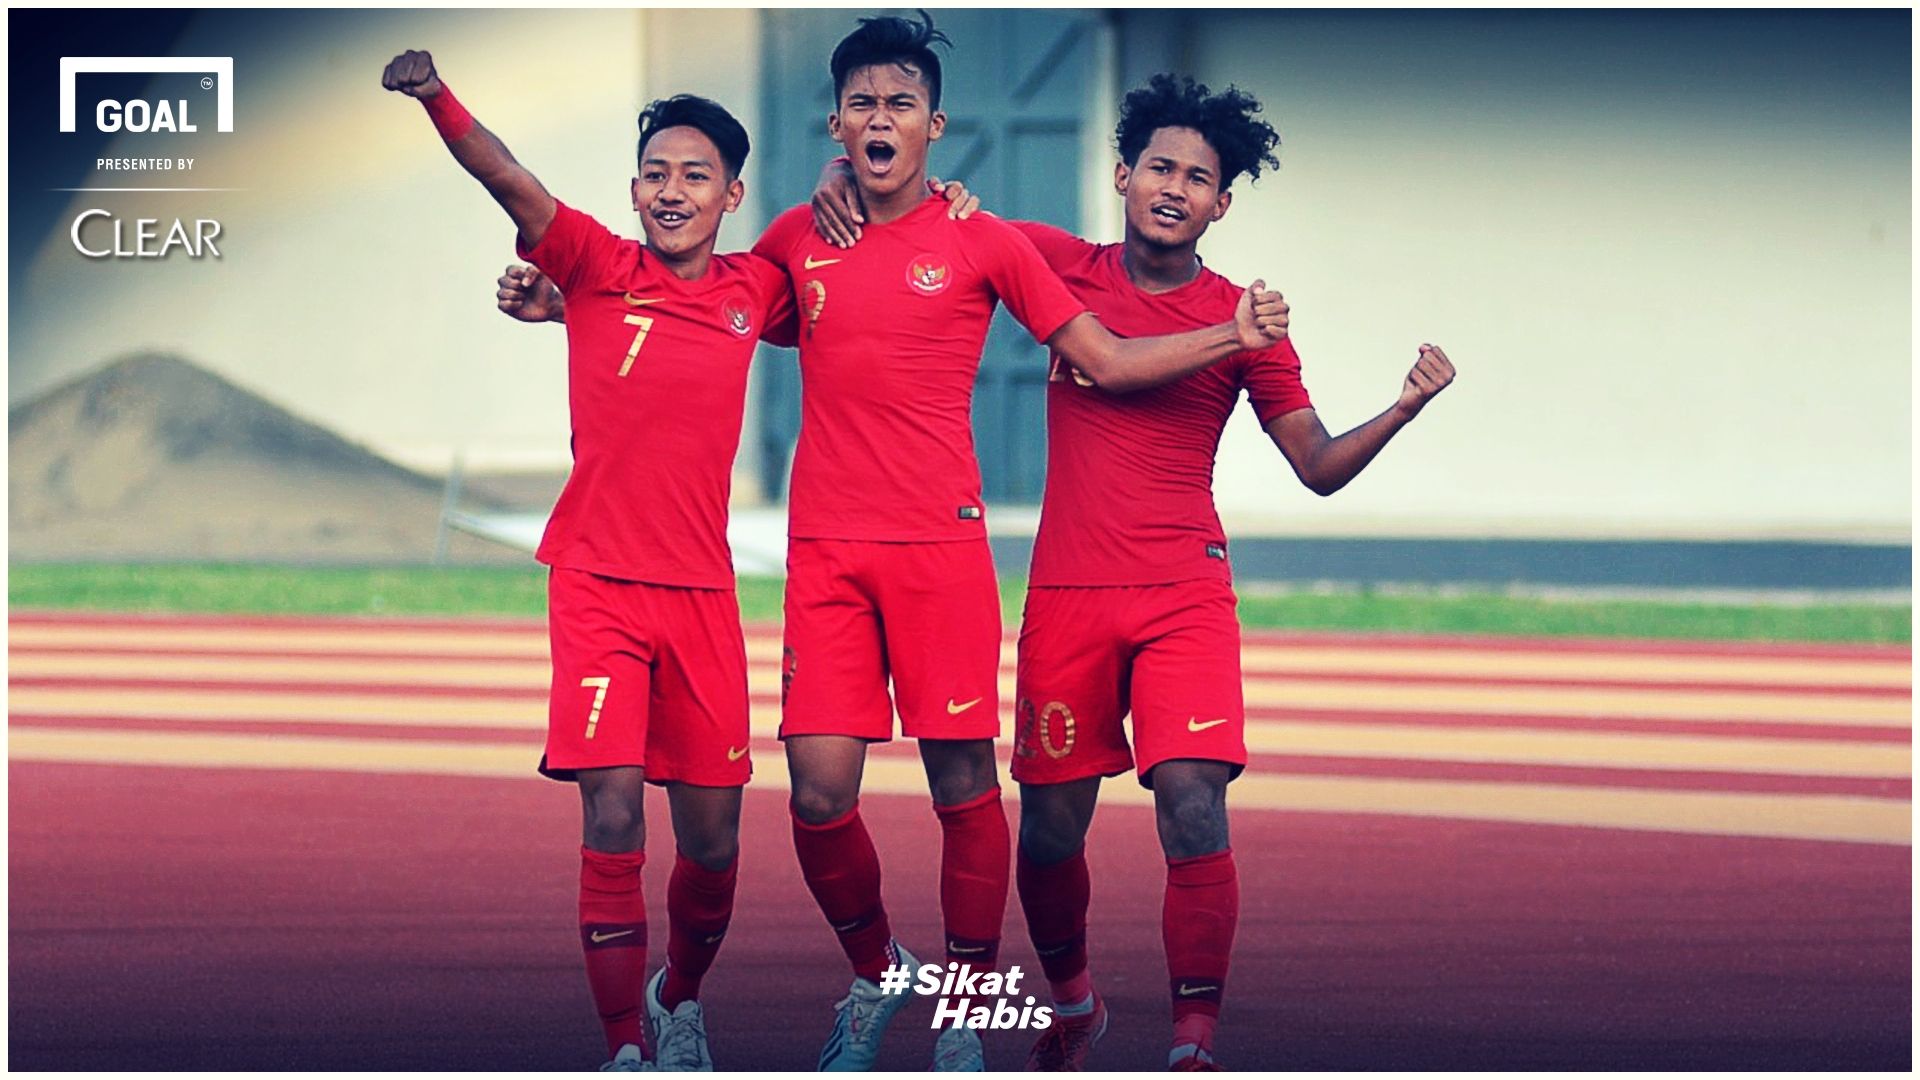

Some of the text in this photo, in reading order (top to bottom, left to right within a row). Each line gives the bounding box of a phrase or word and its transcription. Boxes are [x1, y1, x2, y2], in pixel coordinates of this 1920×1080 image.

[617, 313, 654, 378] 7
[579, 676, 611, 740] 7
[1016, 698, 1076, 759] 20
